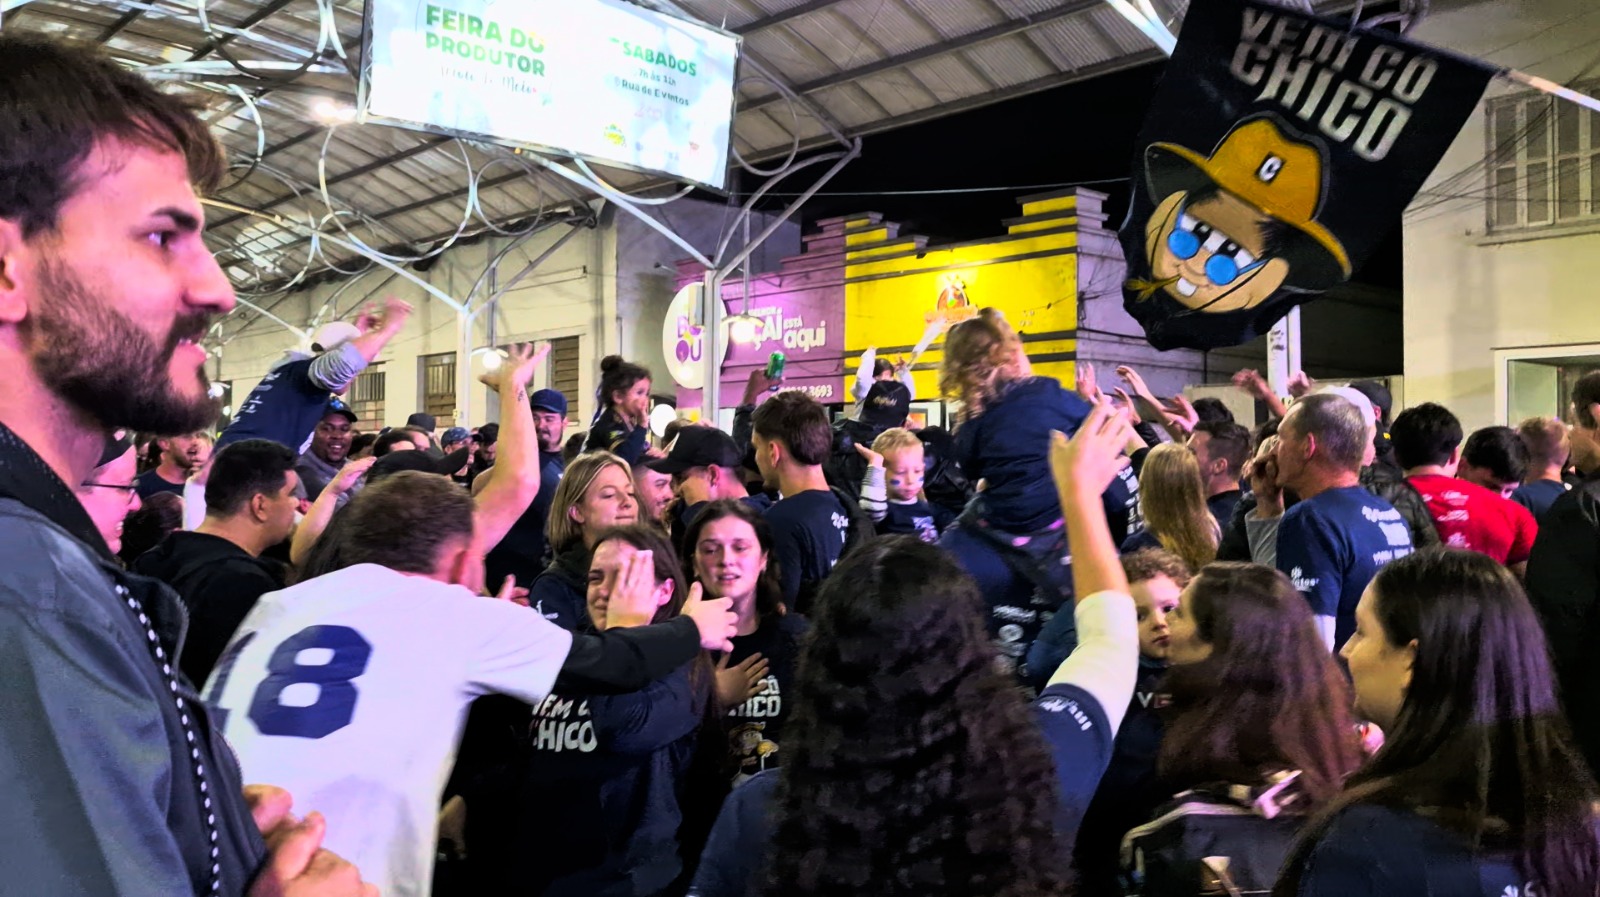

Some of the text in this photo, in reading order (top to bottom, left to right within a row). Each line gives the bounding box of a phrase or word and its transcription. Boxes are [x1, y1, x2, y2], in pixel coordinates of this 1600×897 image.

[426, 4, 545, 54] FEIRA DO
[425, 31, 545, 77] PRODUTOR
[621, 79, 640, 92] Rua
[641, 85, 652, 95] de
[1230, 41, 1413, 162] CHICO
[783, 320, 826, 352] aqui
